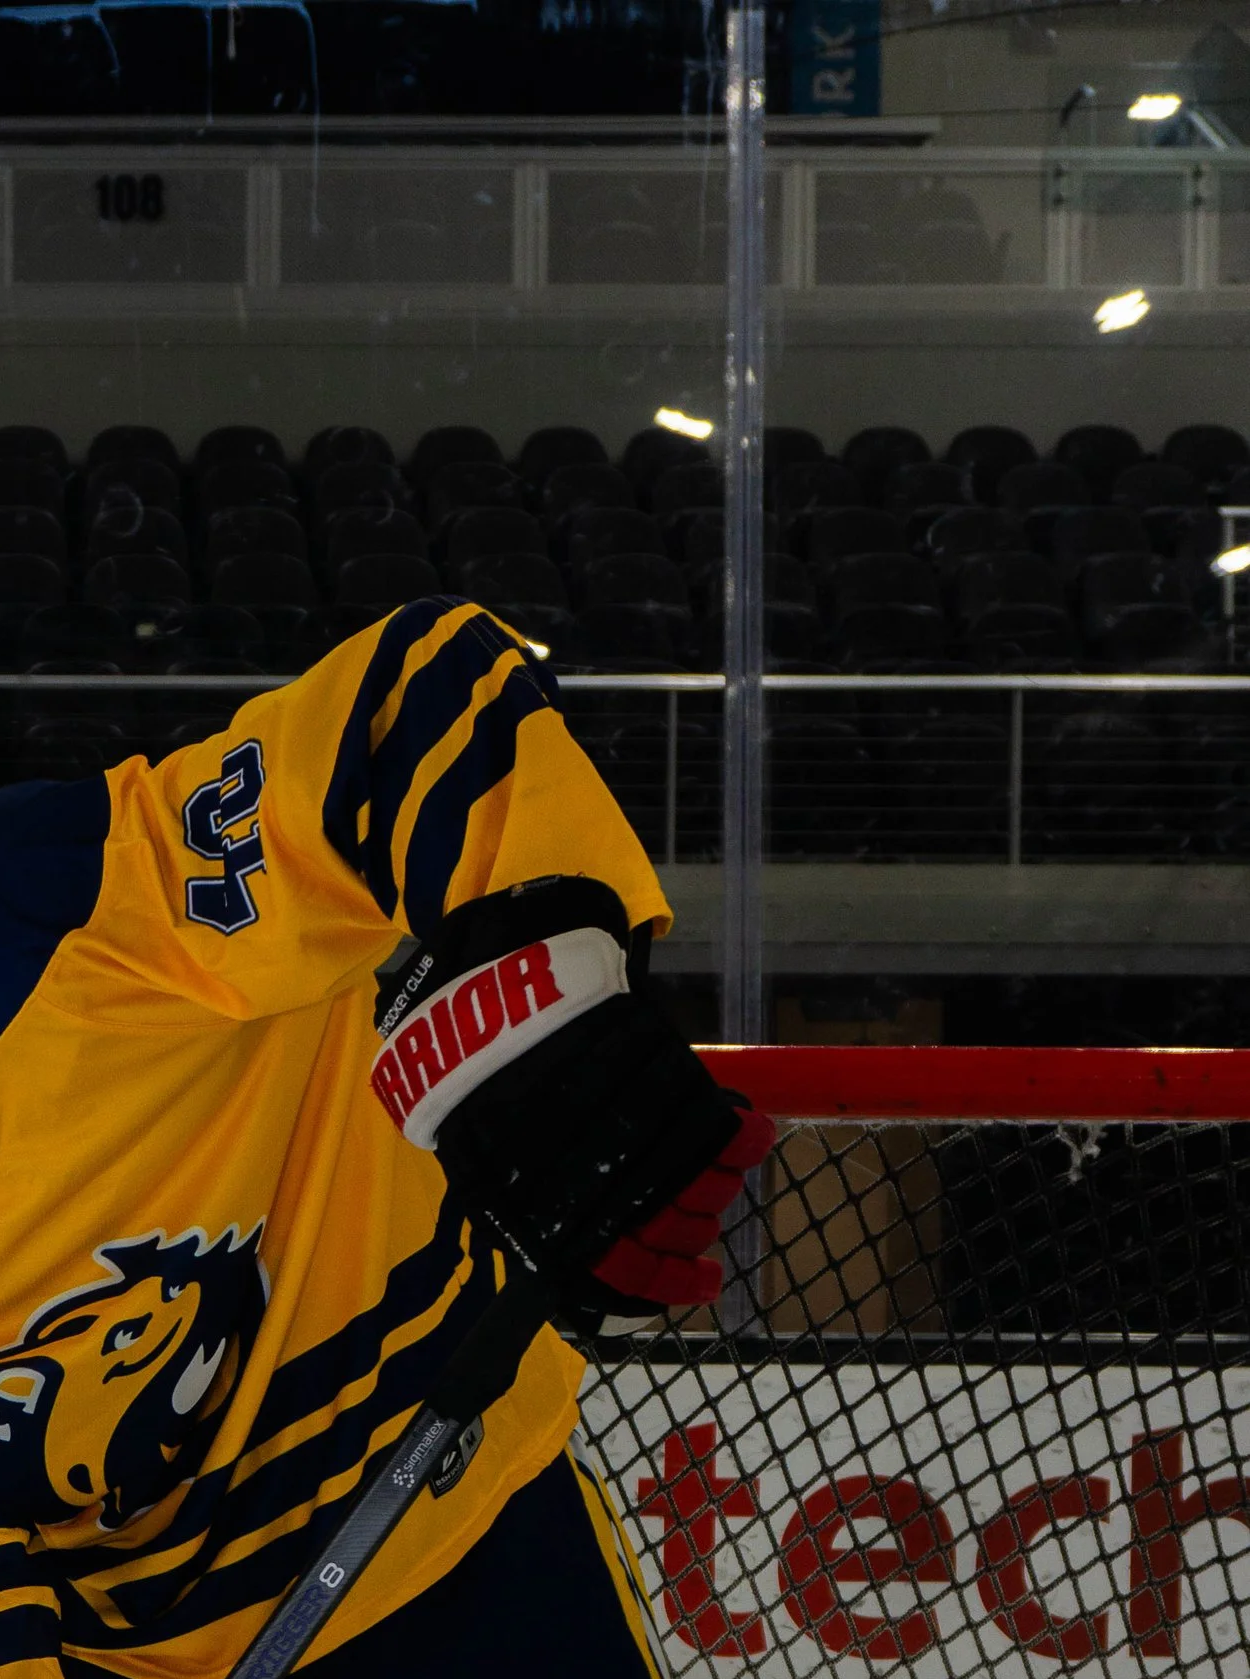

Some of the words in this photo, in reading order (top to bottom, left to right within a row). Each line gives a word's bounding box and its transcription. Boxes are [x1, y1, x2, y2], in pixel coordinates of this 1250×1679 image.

[811, 17, 856, 117] RK
[96, 173, 163, 221] 108
[381, 988, 411, 1029] HOCKEY
[406, 953, 435, 993] CLUB
[370, 941, 564, 1135] RRIOR
[319, 1562, 345, 1588] 8
